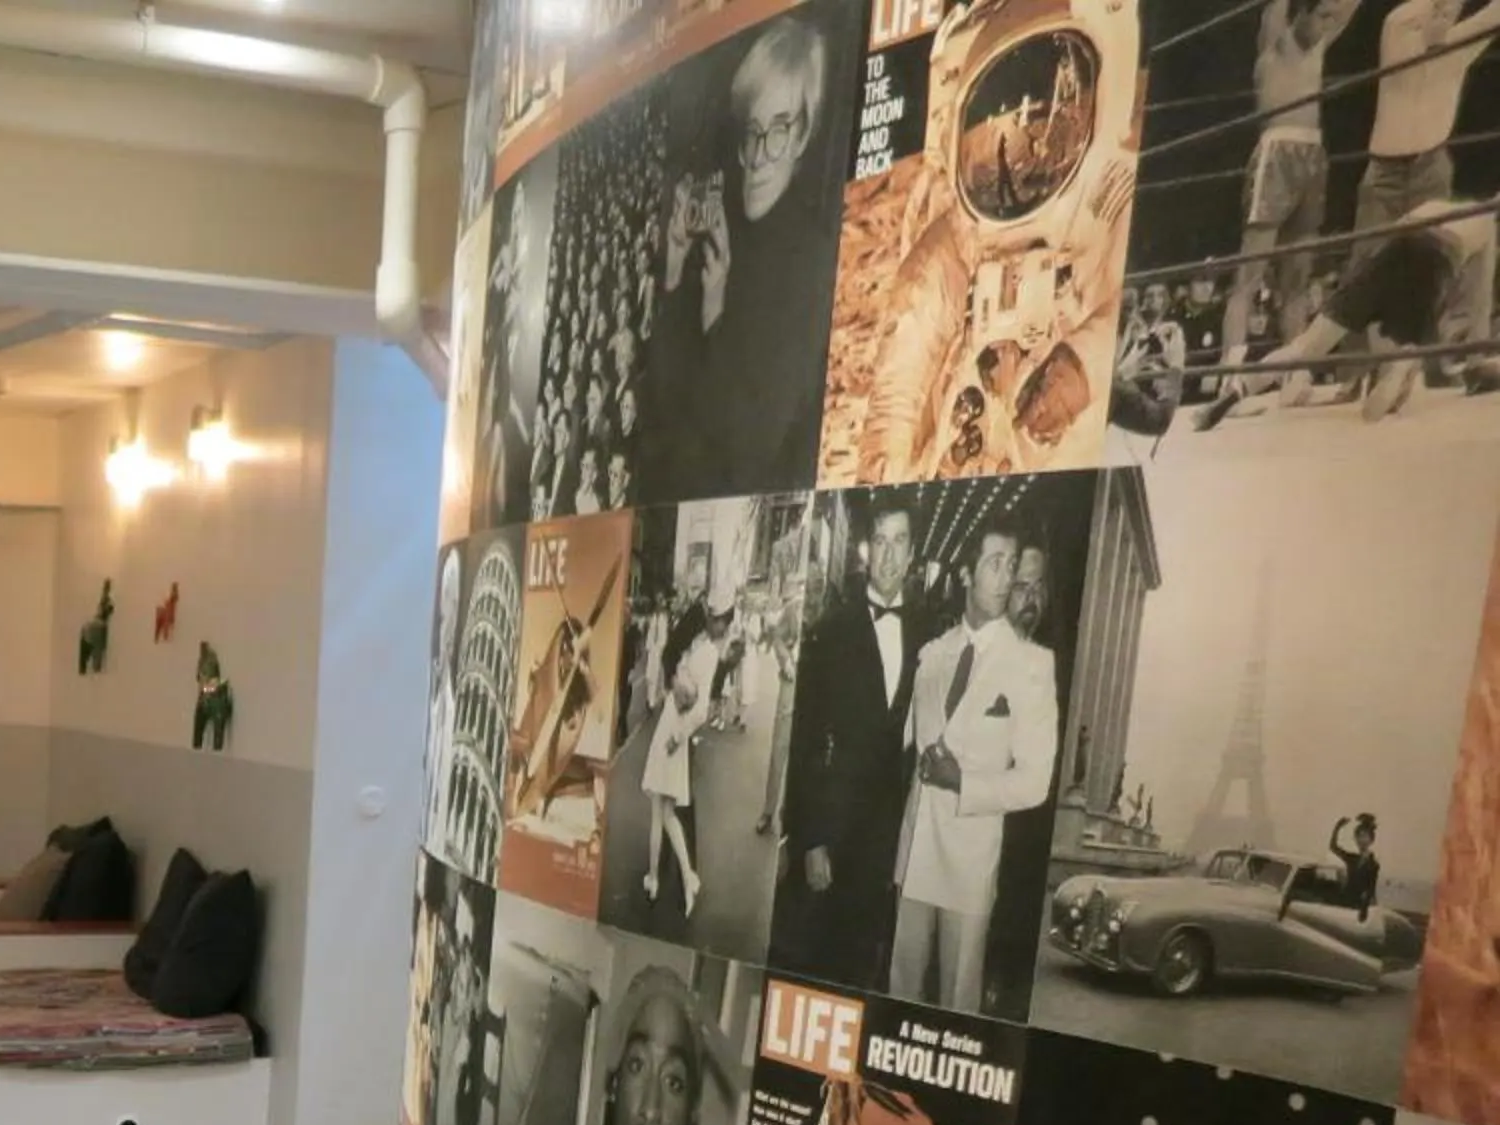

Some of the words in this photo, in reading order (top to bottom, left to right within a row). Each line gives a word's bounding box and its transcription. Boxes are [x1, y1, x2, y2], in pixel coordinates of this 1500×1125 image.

[871, 0, 943, 46] LIFE
[867, 54, 884, 80] TO
[864, 76, 891, 104] THE
[861, 96, 904, 130] MOON
[858, 126, 889, 155] AND
[855, 148, 893, 180] BACK
[529, 538, 568, 586] LIFE
[766, 988, 858, 1073] LIFE
[899, 1020, 909, 1038] A
[911, 1023, 938, 1045] New
[942, 1030, 982, 1056] Series
[866, 1035, 1015, 1104] REVOLUTION
